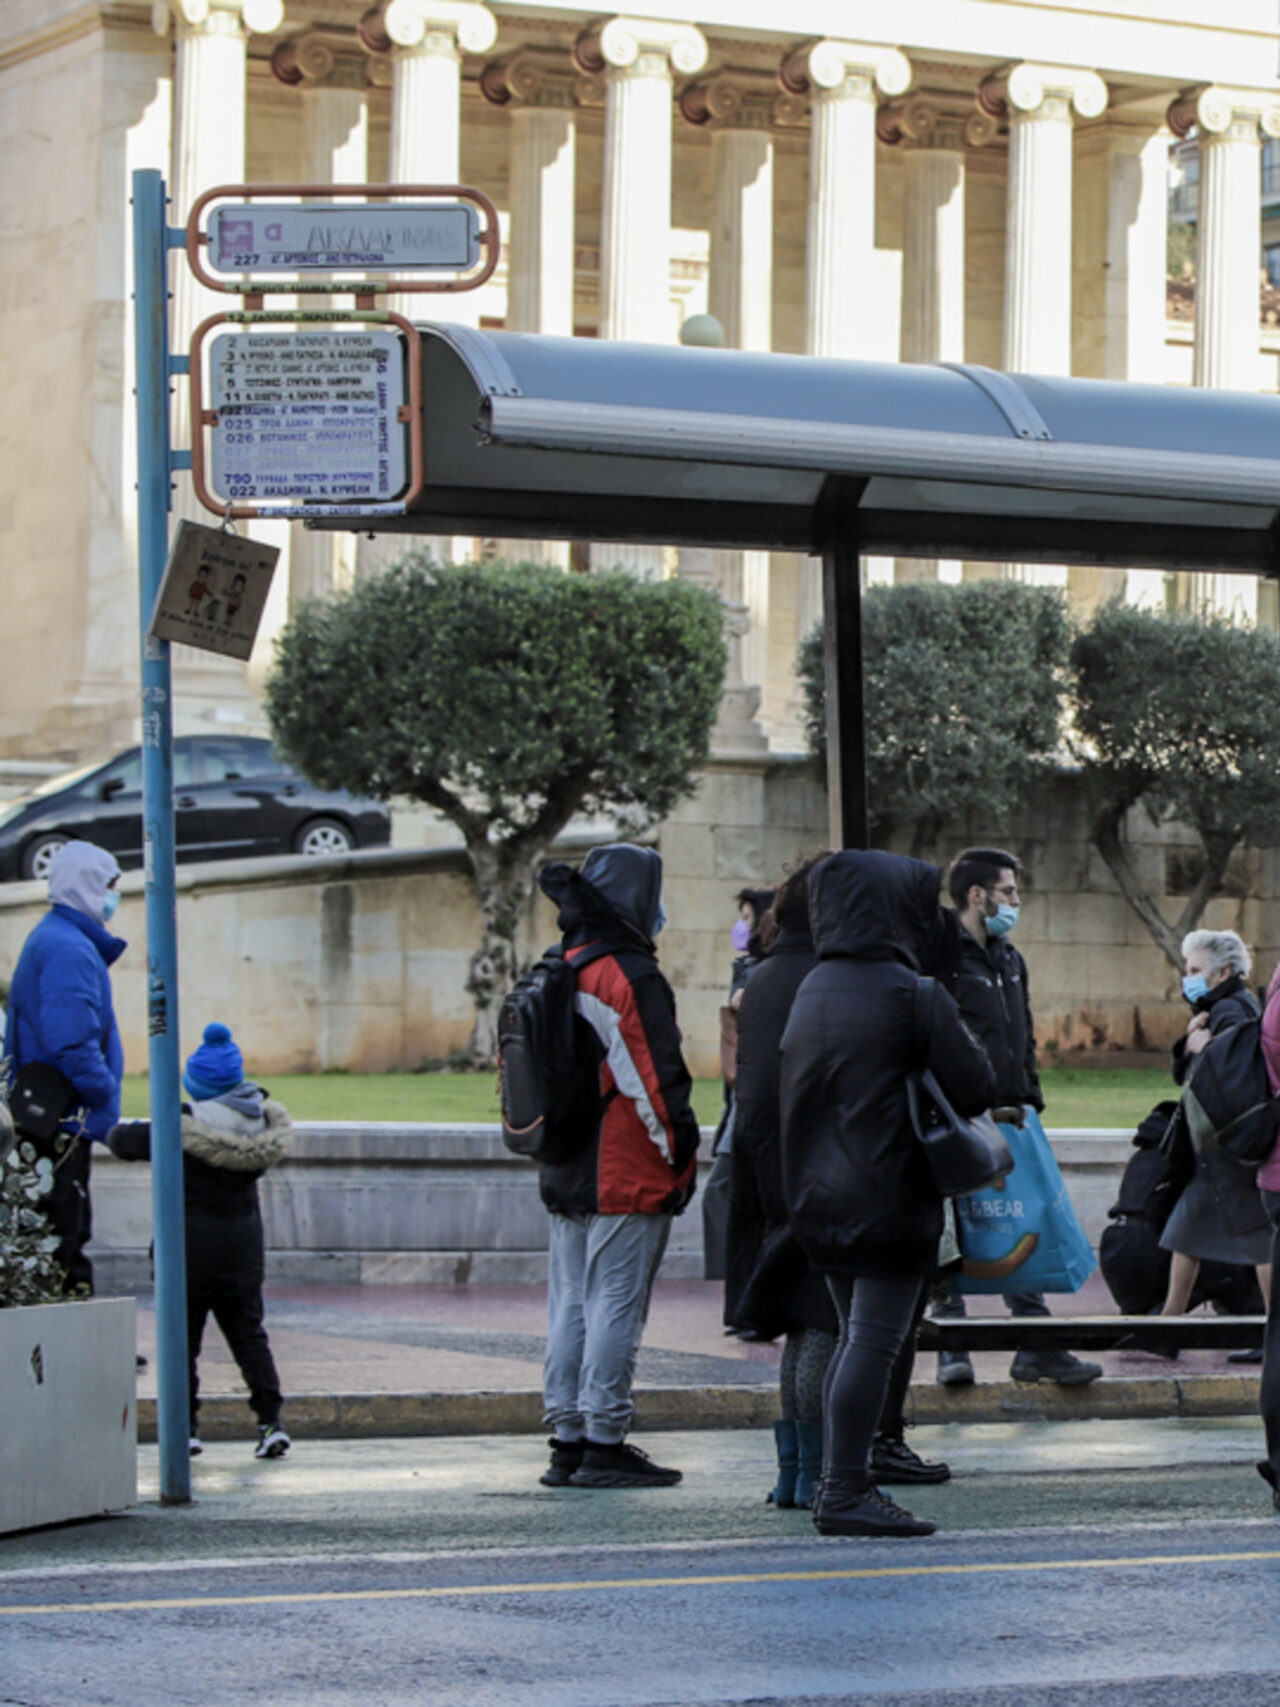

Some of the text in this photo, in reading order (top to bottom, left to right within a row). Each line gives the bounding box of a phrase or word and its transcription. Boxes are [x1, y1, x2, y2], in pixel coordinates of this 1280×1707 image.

[234, 254, 260, 266] 227
[229, 313, 245, 322] 12
[227, 337, 237, 348] 2
[226, 351, 236, 361] 3
[225, 363, 236, 374] 4
[227, 379, 236, 389] 5
[225, 393, 241, 401] 11
[225, 418, 253, 430] 025
[225, 433, 254, 444] 026
[224, 473, 252, 485] 790
[229, 485, 257, 498] 022
